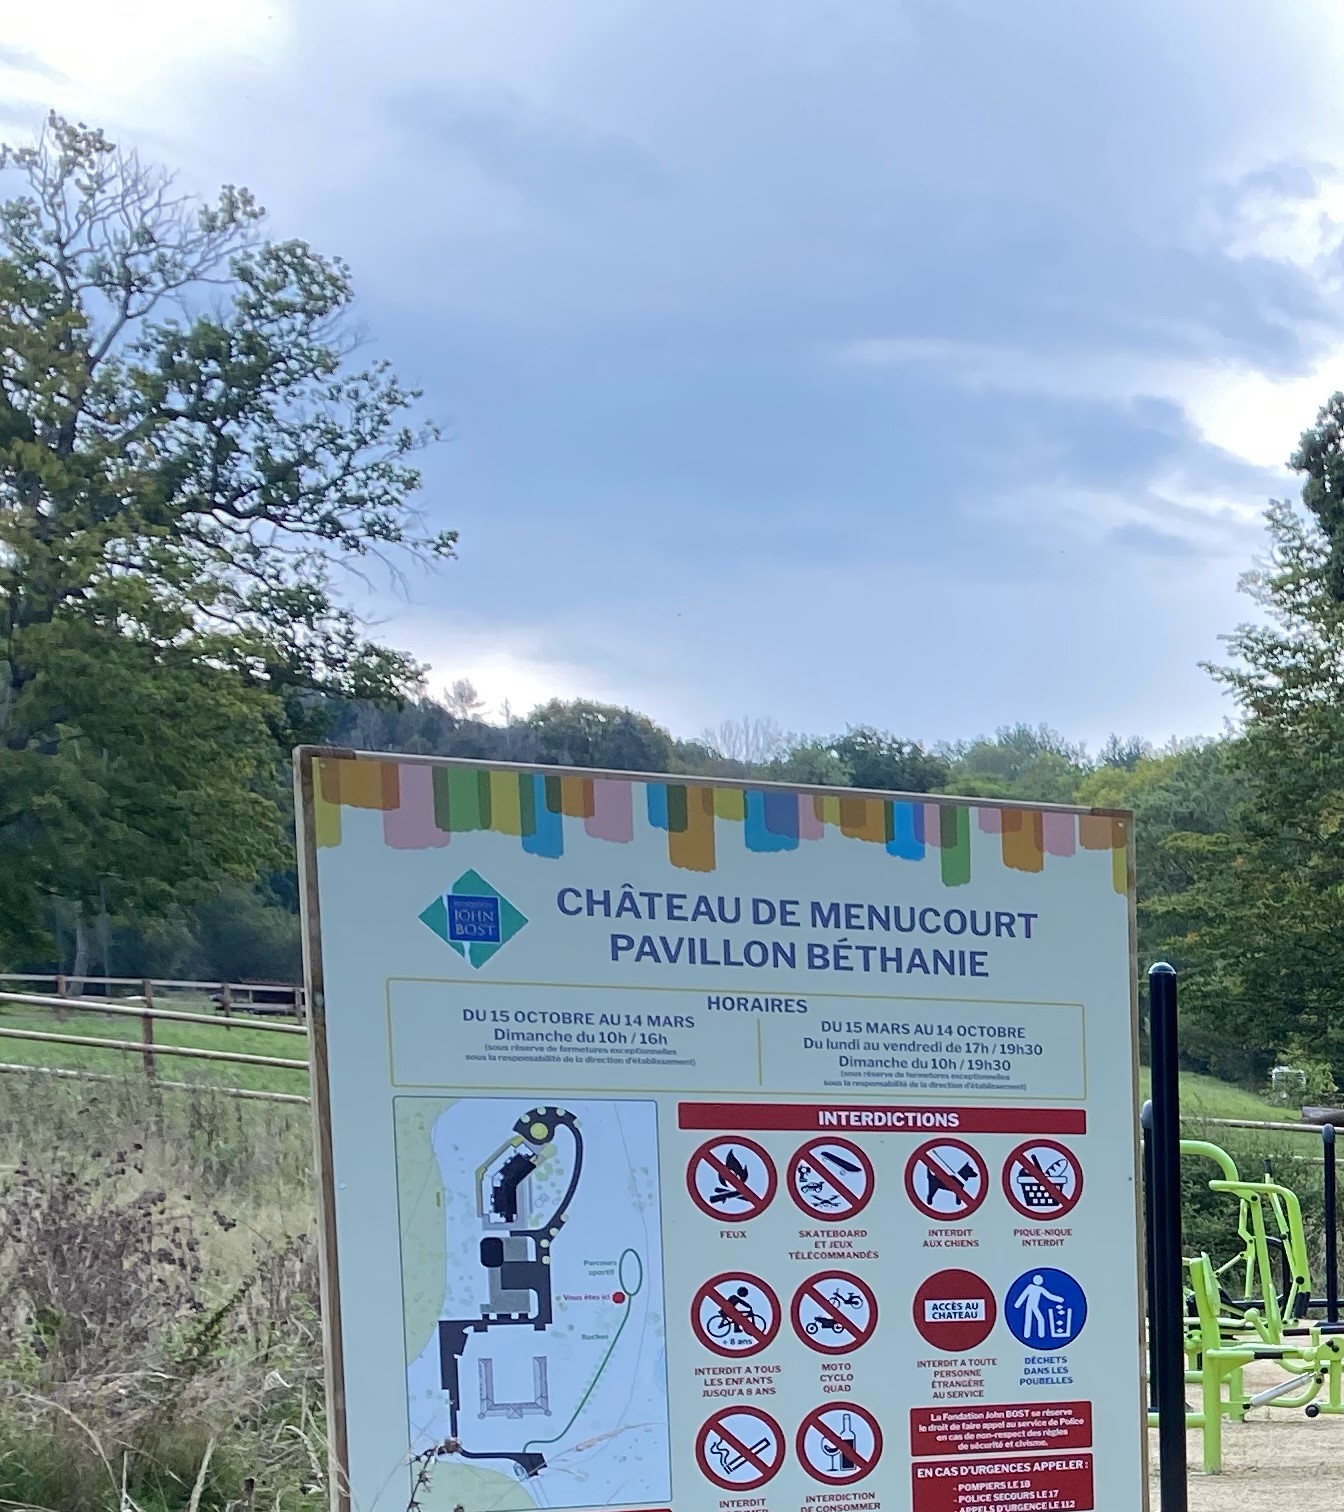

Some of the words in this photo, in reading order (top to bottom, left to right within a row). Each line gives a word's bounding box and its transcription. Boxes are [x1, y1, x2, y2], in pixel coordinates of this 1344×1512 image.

[454, 909, 494, 923] JOHN
[556, 886, 747, 925] CHÂTEAU
[752, 896, 800, 928] DE
[809, 900, 1039, 939] MENUCOURT
[455, 923, 494, 936] BOST
[610, 933, 799, 970] PAVILLON
[807, 937, 989, 978] BÉTHANIE
[707, 995, 807, 1014] HORAIRES
[463, 1009, 486, 1022] DU
[491, 1011, 510, 1023] 15
[514, 1011, 594, 1025] OCTOBRE
[599, 1014, 620, 1026] AU
[625, 1015, 642, 1026] 14
[647, 1016, 695, 1028] MARS
[821, 1020, 842, 1032] DU
[846, 1021, 862, 1033] 15
[866, 1022, 910, 1034] MARS
[914, 1024, 934, 1035] AU
[937, 1025, 952, 1036] 14
[956, 1026, 1026, 1038] OCTOBRE
[494, 1028, 573, 1042] Dimanche
[576, 1031, 594, 1043] du
[599, 1032, 627, 1044] 10h
[640, 1033, 668, 1045] 16h
[804, 1038, 824, 1049] Du
[826, 1038, 860, 1050] lundi
[863, 1042, 880, 1051] au
[883, 1040, 942, 1052] vendredi
[946, 1042, 962, 1053] de
[965, 1042, 988, 1054] 17h
[1000, 1044, 1042, 1056] 19h30
[839, 1056, 908, 1069] Dimanche
[912, 1058, 928, 1069] du
[931, 1058, 956, 1070] 10h
[968, 1059, 1010, 1071] 19h30
[818, 1110, 960, 1128] INTERDICTIONS
[720, 1231, 746, 1239] FEUX
[799, 1230, 867, 1238] SKATEBOARD
[1014, 1228, 1072, 1236] PIQUE-NIQUE
[815, 1241, 826, 1249] ET
[829, 1241, 853, 1249] JEUX
[789, 1250, 879, 1260] TÉLÉCOMMANDÉS
[932, 1301, 963, 1310] ACCÈS
[932, 1311, 978, 1320] CHATEAU
[917, 1359, 957, 1368] INTERDIT
[969, 1358, 997, 1366] TOUTE
[1025, 1356, 1067, 1364] DÉCHETS
[694, 1366, 742, 1376] INTERDIT
[744, 1366, 752, 1374] A
[755, 1365, 781, 1374] TOUS
[822, 1363, 851, 1371] MOTO
[1024, 1367, 1050, 1375] DANS
[820, 1374, 853, 1382] CYCLO
[934, 1369, 981, 1378] PERSONNE
[704, 1378, 723, 1386] LES
[725, 1377, 772, 1385] ENFANTS
[932, 1379, 984, 1389] ÉTRANGÈRE
[1020, 1377, 1073, 1386] POUBELLES
[703, 1388, 745, 1397] JUSQU'A
[756, 1387, 776, 1395] ANS
[823, 1384, 851, 1393] QUAD
[932, 1391, 946, 1399] AU
[948, 1390, 984, 1398] SERVICE
[917, 1468, 932, 1478] EN
[935, 1466, 958, 1477] CAS
[960, 1463, 1031, 1476] D'URGENCES
[1033, 1460, 1083, 1471] APPELER
[958, 1482, 1006, 1491] POMPIERS
[1020, 1480, 1031, 1488] 18
[806, 1492, 875, 1503] INTERDICTION
[958, 1494, 991, 1503] POLICE
[993, 1491, 1035, 1501] SECOURS
[1037, 1490, 1048, 1498] LE
[719, 1499, 766, 1508] INTERDIT
[816, 1503, 880, 1512] CONSOMMER
[997, 1502, 1047, 1512] D'URGENCE
